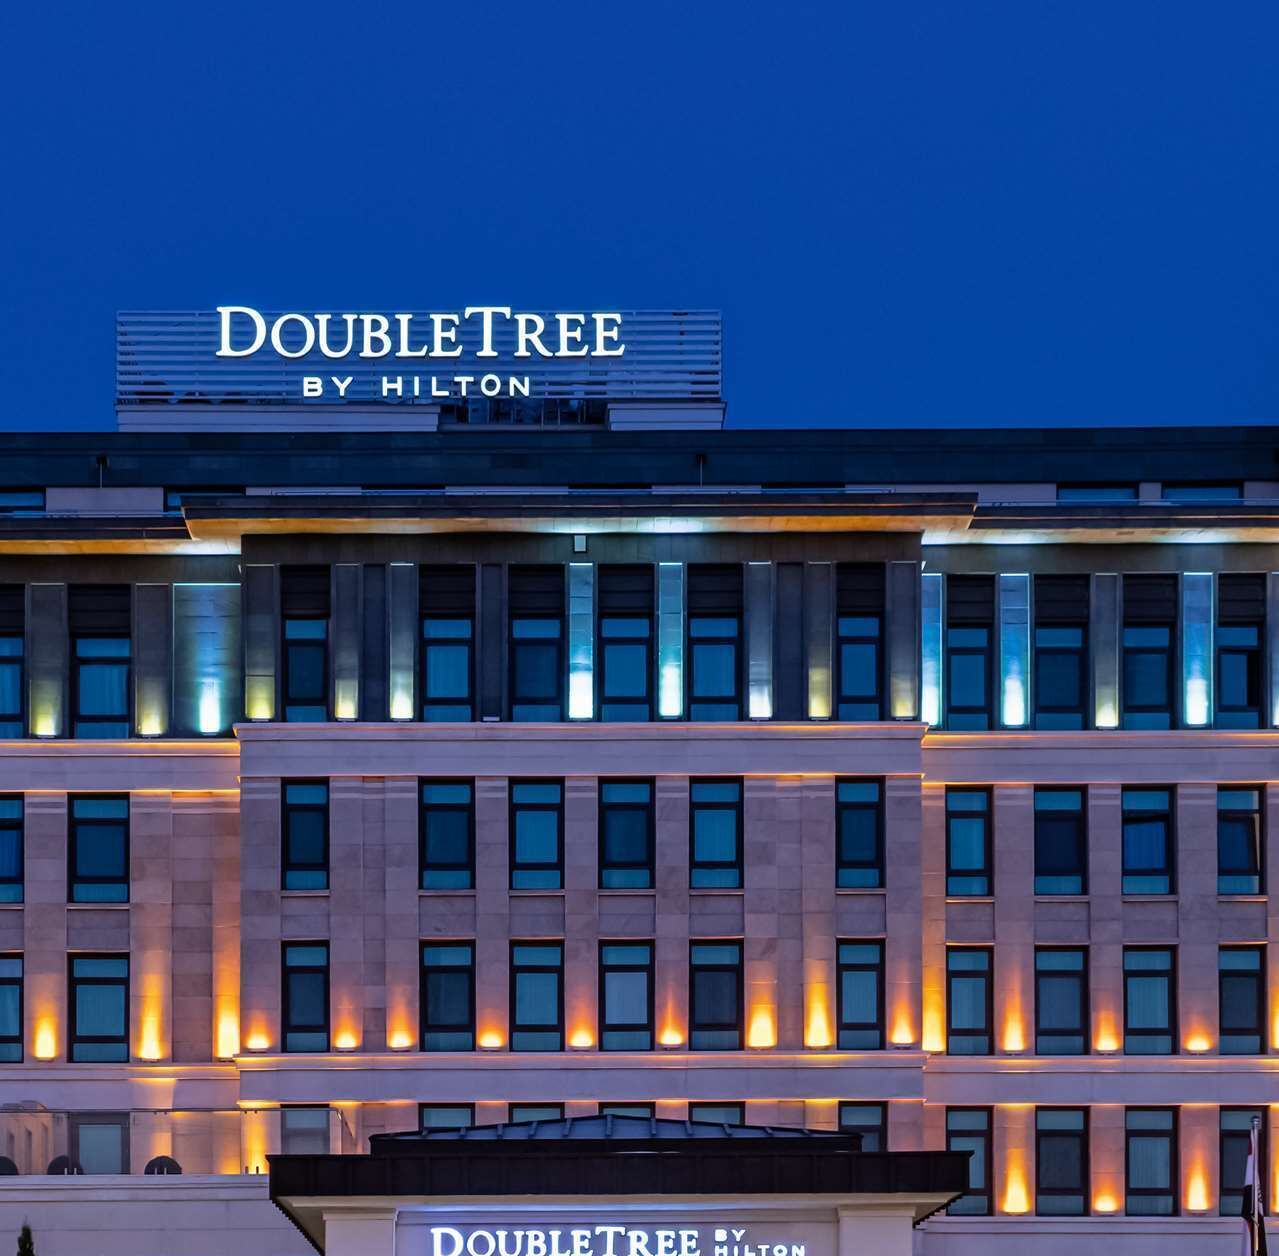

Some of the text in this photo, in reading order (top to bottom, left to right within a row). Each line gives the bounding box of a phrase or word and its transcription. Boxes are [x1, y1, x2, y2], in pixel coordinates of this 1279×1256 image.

[215, 305, 627, 358] DOUBLETREE
[303, 373, 530, 398] BY HILTON
[714, 1229, 746, 1242] BY
